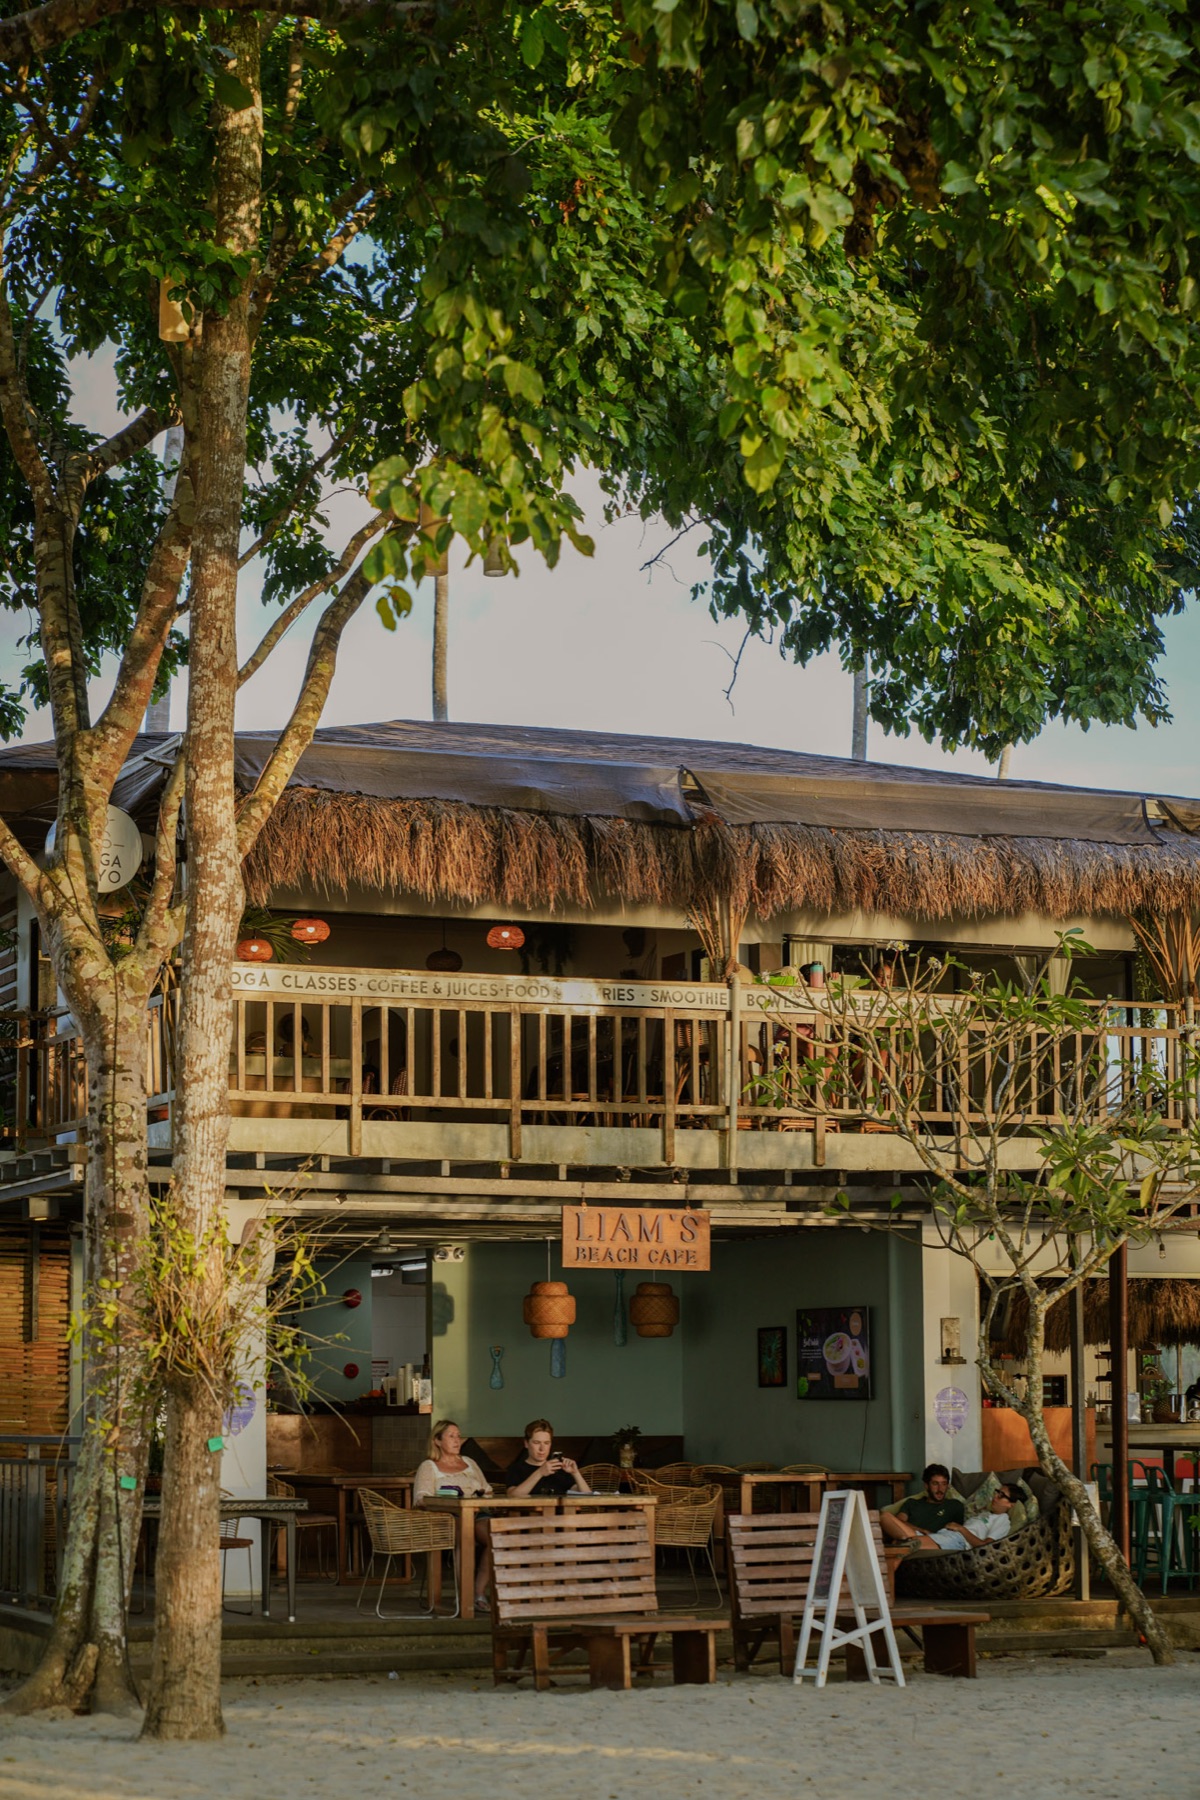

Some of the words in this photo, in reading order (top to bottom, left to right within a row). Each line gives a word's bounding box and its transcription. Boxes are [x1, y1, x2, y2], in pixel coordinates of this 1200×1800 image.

[230, 971, 270, 987] OGA
[281, 975, 357, 991] CLASSES
[367, 979, 428, 994] COFFEE
[432, 981, 442, 995] &
[447, 982, 499, 997] JUICES
[505, 984, 550, 998] FOOD
[651, 990, 728, 1006] SMOOTHIE
[575, 1212, 699, 1243] LIAM'S
[575, 1246, 639, 1264] BEACH
[648, 1248, 698, 1266] CAFE
